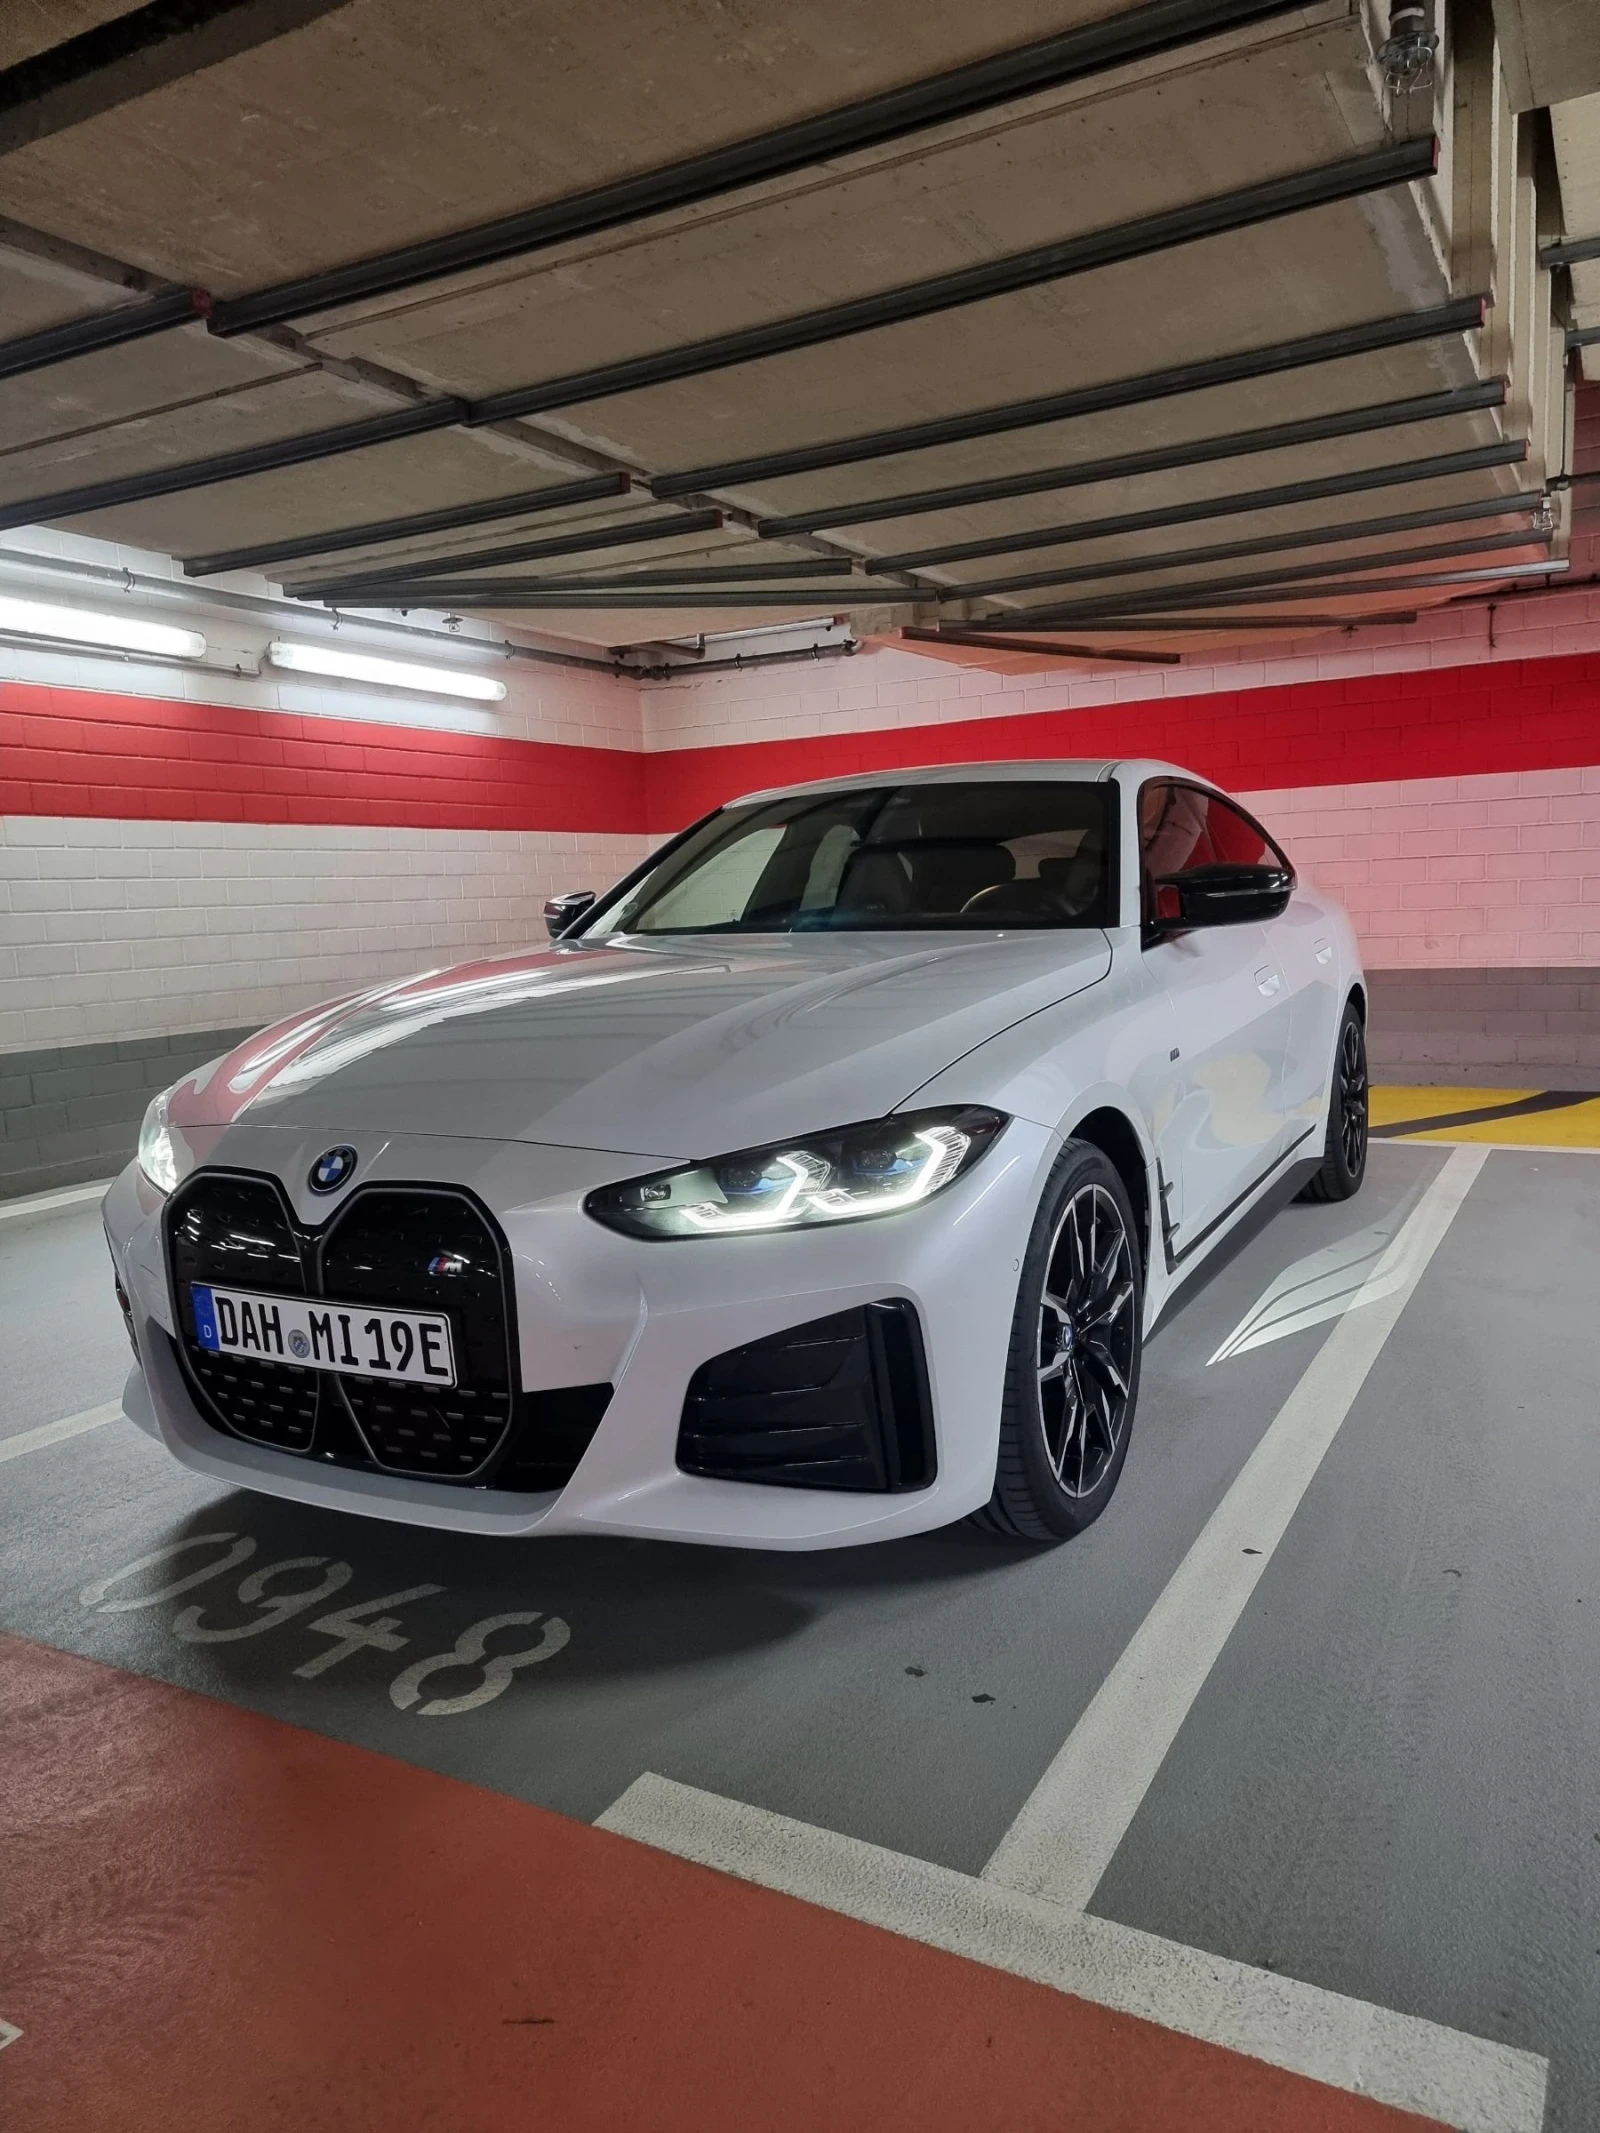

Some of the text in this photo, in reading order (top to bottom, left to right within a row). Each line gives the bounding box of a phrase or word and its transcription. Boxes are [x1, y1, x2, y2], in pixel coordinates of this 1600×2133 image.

[204, 1324, 212, 1338] D
[215, 1297, 284, 1355] DAH
[78, 1532, 571, 1715] 0948
